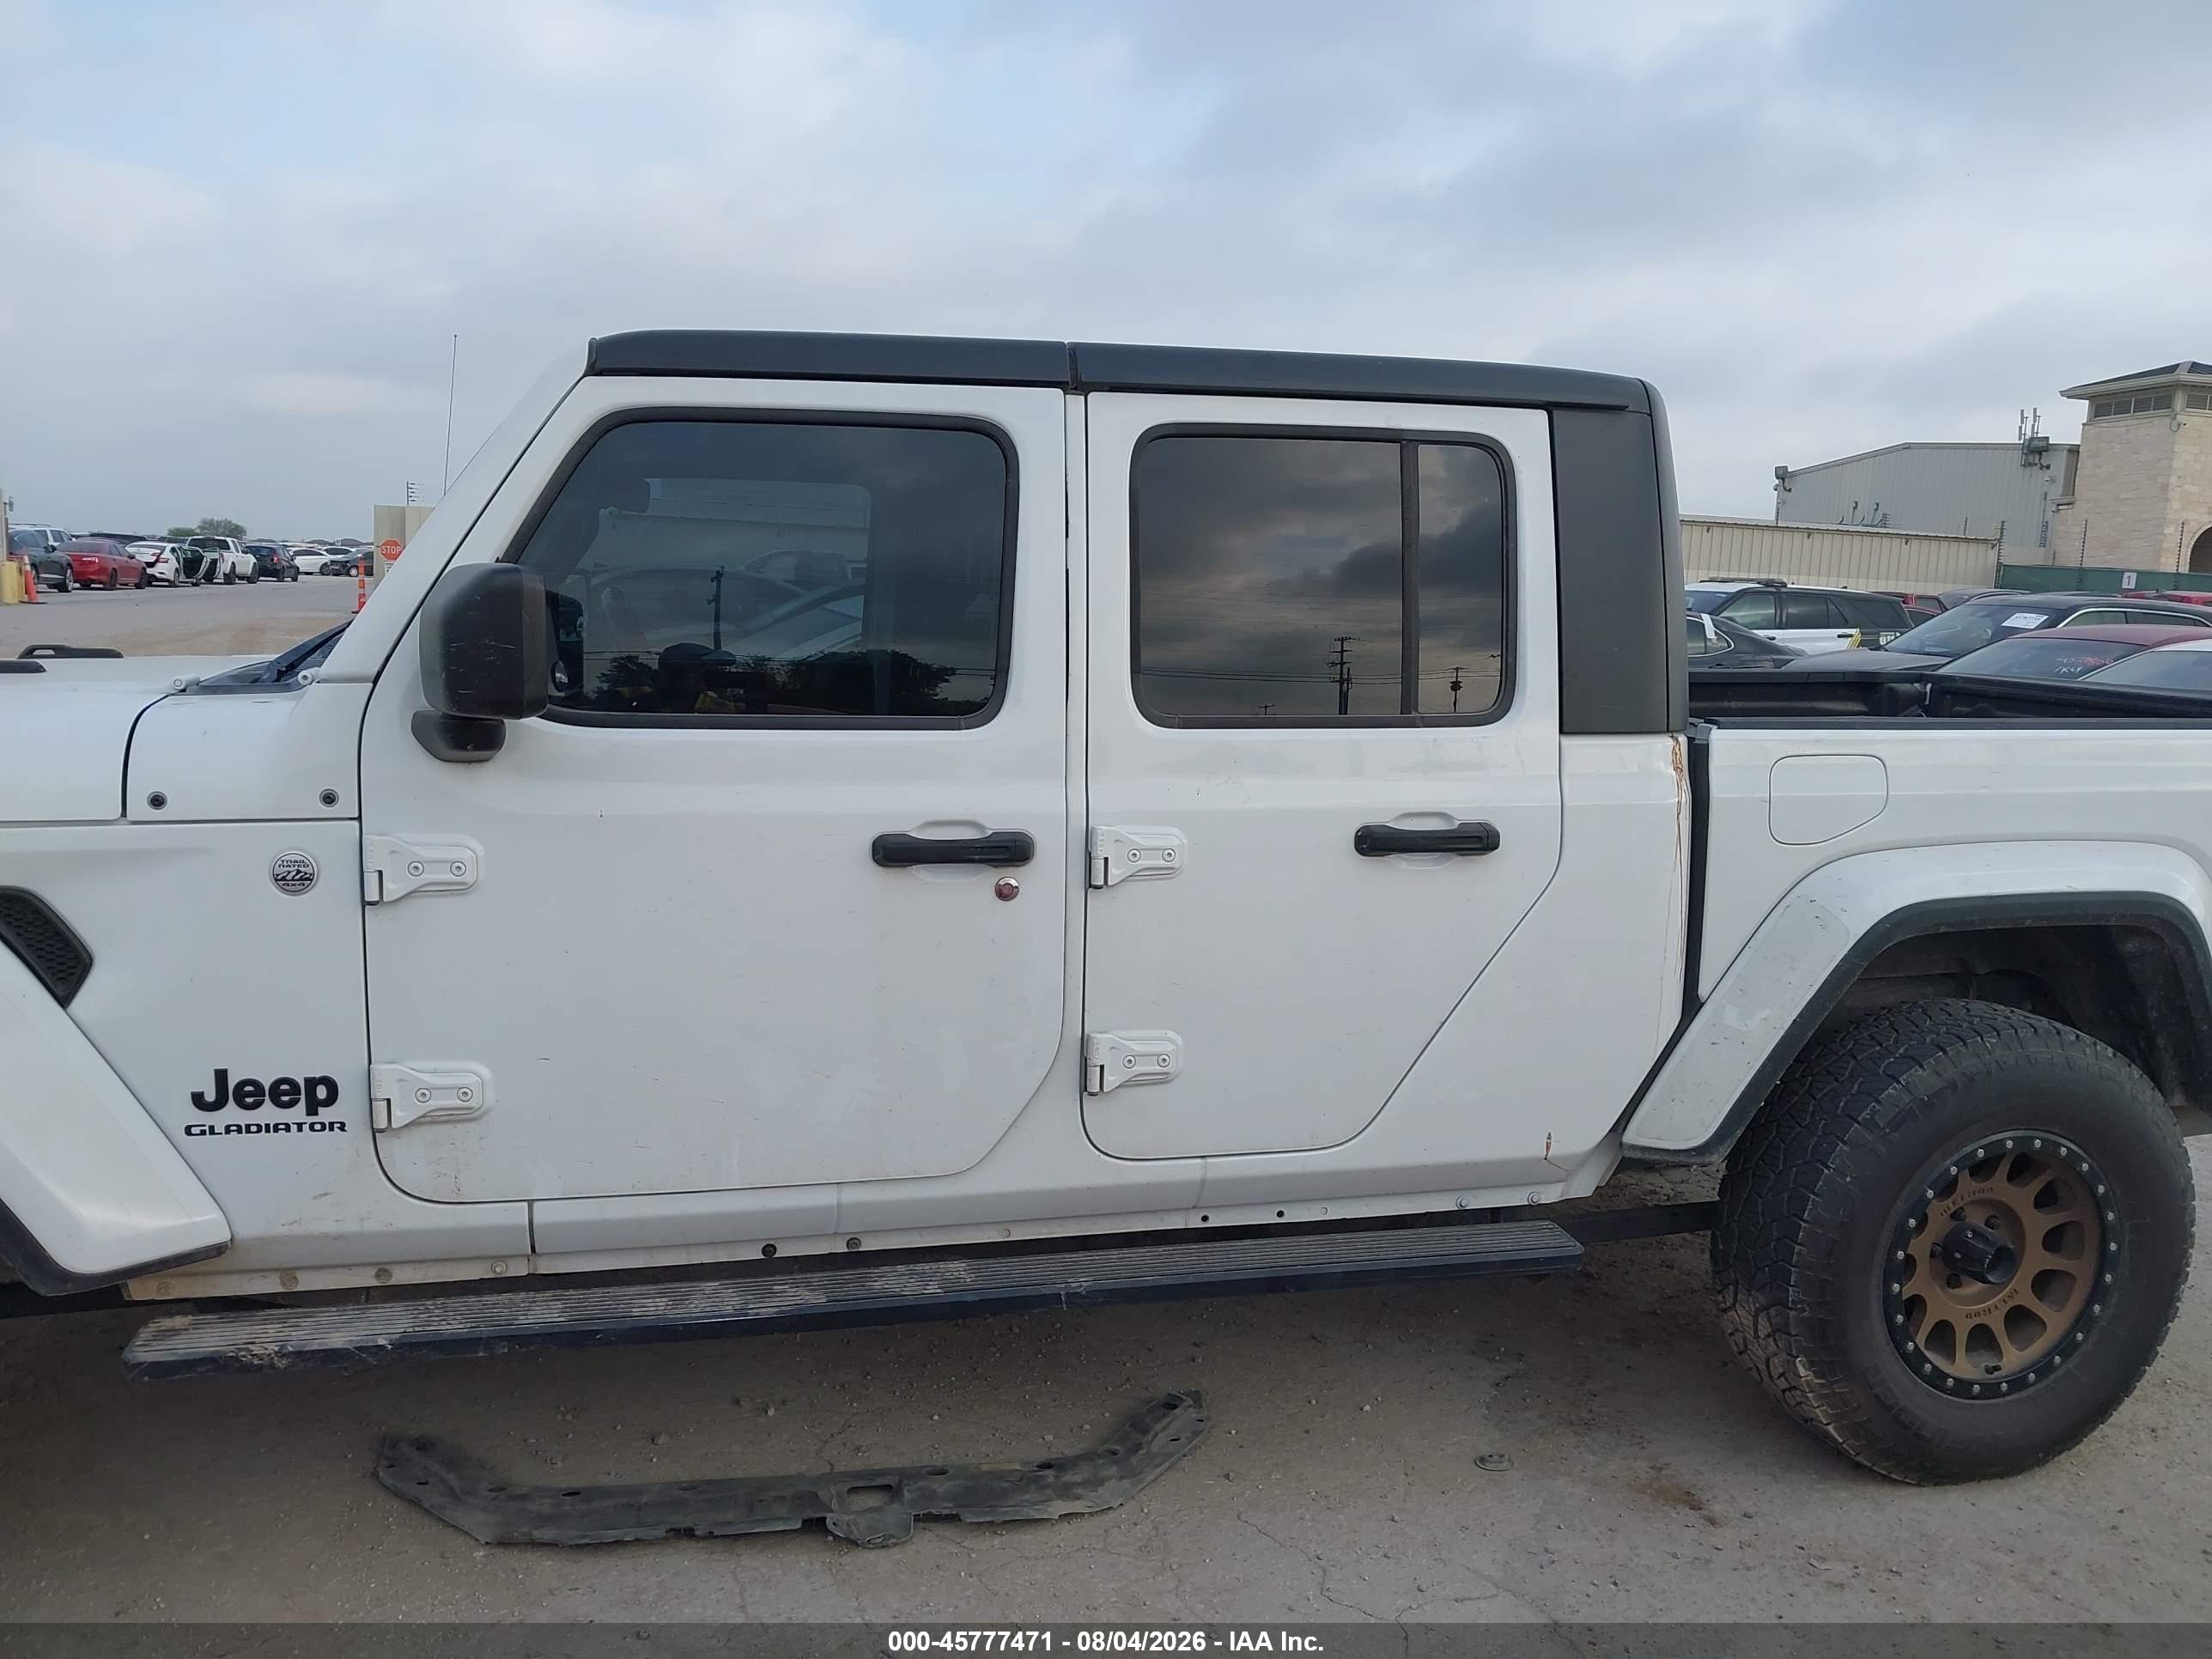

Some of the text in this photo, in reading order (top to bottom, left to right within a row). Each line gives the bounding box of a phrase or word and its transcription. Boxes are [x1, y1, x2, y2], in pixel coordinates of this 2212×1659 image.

[381, 545, 401, 555] STOP
[2126, 574, 2131, 586] 1
[191, 1068, 339, 1116] Jeep
[184, 1121, 349, 1137] GLADIATOR
